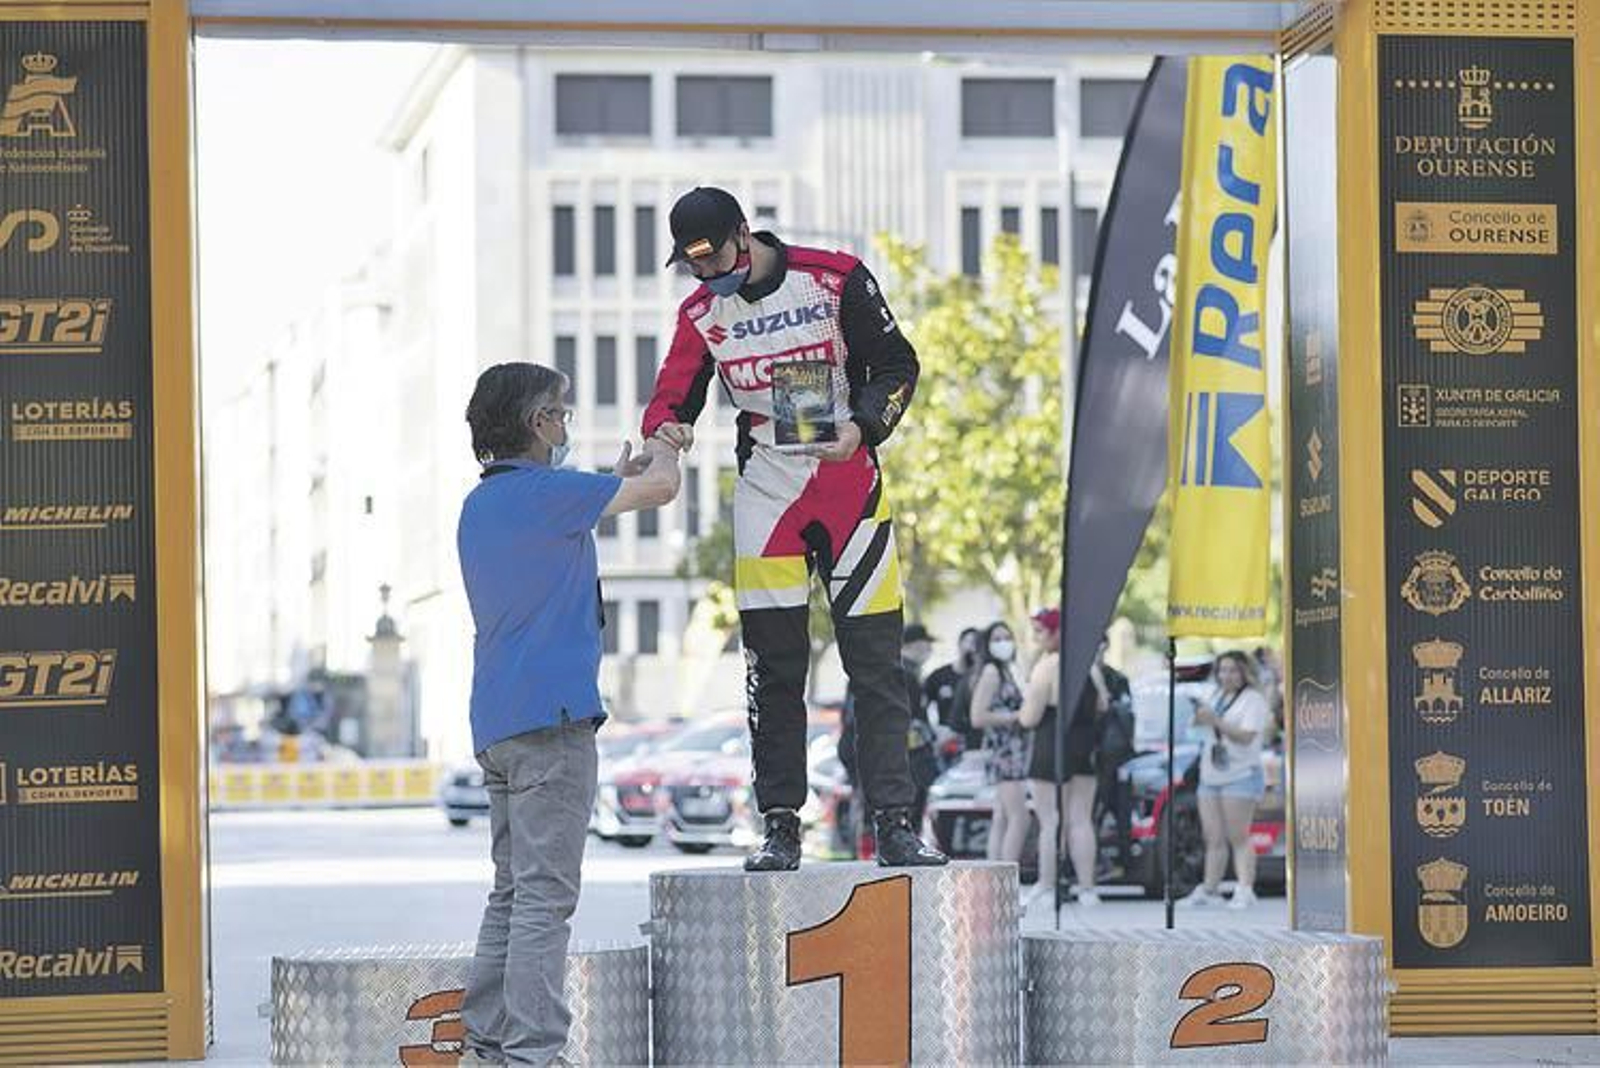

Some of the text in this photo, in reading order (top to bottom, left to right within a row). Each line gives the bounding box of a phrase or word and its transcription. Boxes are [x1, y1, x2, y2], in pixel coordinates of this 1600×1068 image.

[1395, 133, 1555, 155] DEPUTACIÓN
[1417, 159, 1535, 178] OURENSE
[1449, 211, 1546, 224] Concello de
[1449, 229, 1549, 243] OURENSE
[0, 301, 108, 342] GT2i
[1435, 390, 1560, 402] XUNTA DE GALICIA
[11, 397, 133, 421] LOTERÍAS
[1464, 470, 1550, 485] DEPORTE
[3, 505, 133, 522] MICHELIN
[1480, 566, 1540, 581] Concello
[0, 653, 114, 696] GT2i
[1479, 666, 1550, 680] Concello de
[1480, 687, 1551, 703] ALLARIZ
[17, 762, 138, 786] LOTERÍAS
[1482, 780, 1533, 792] Concello
[1482, 794, 1530, 816] TOÉN
[9, 871, 139, 889] MICHELIN
[1485, 884, 1536, 898] Concello
[1485, 904, 1568, 921] AMOEIRO
[0, 947, 113, 980] Recalvi
[786, 875, 912, 1068] 1
[1170, 962, 1275, 1048] 2
